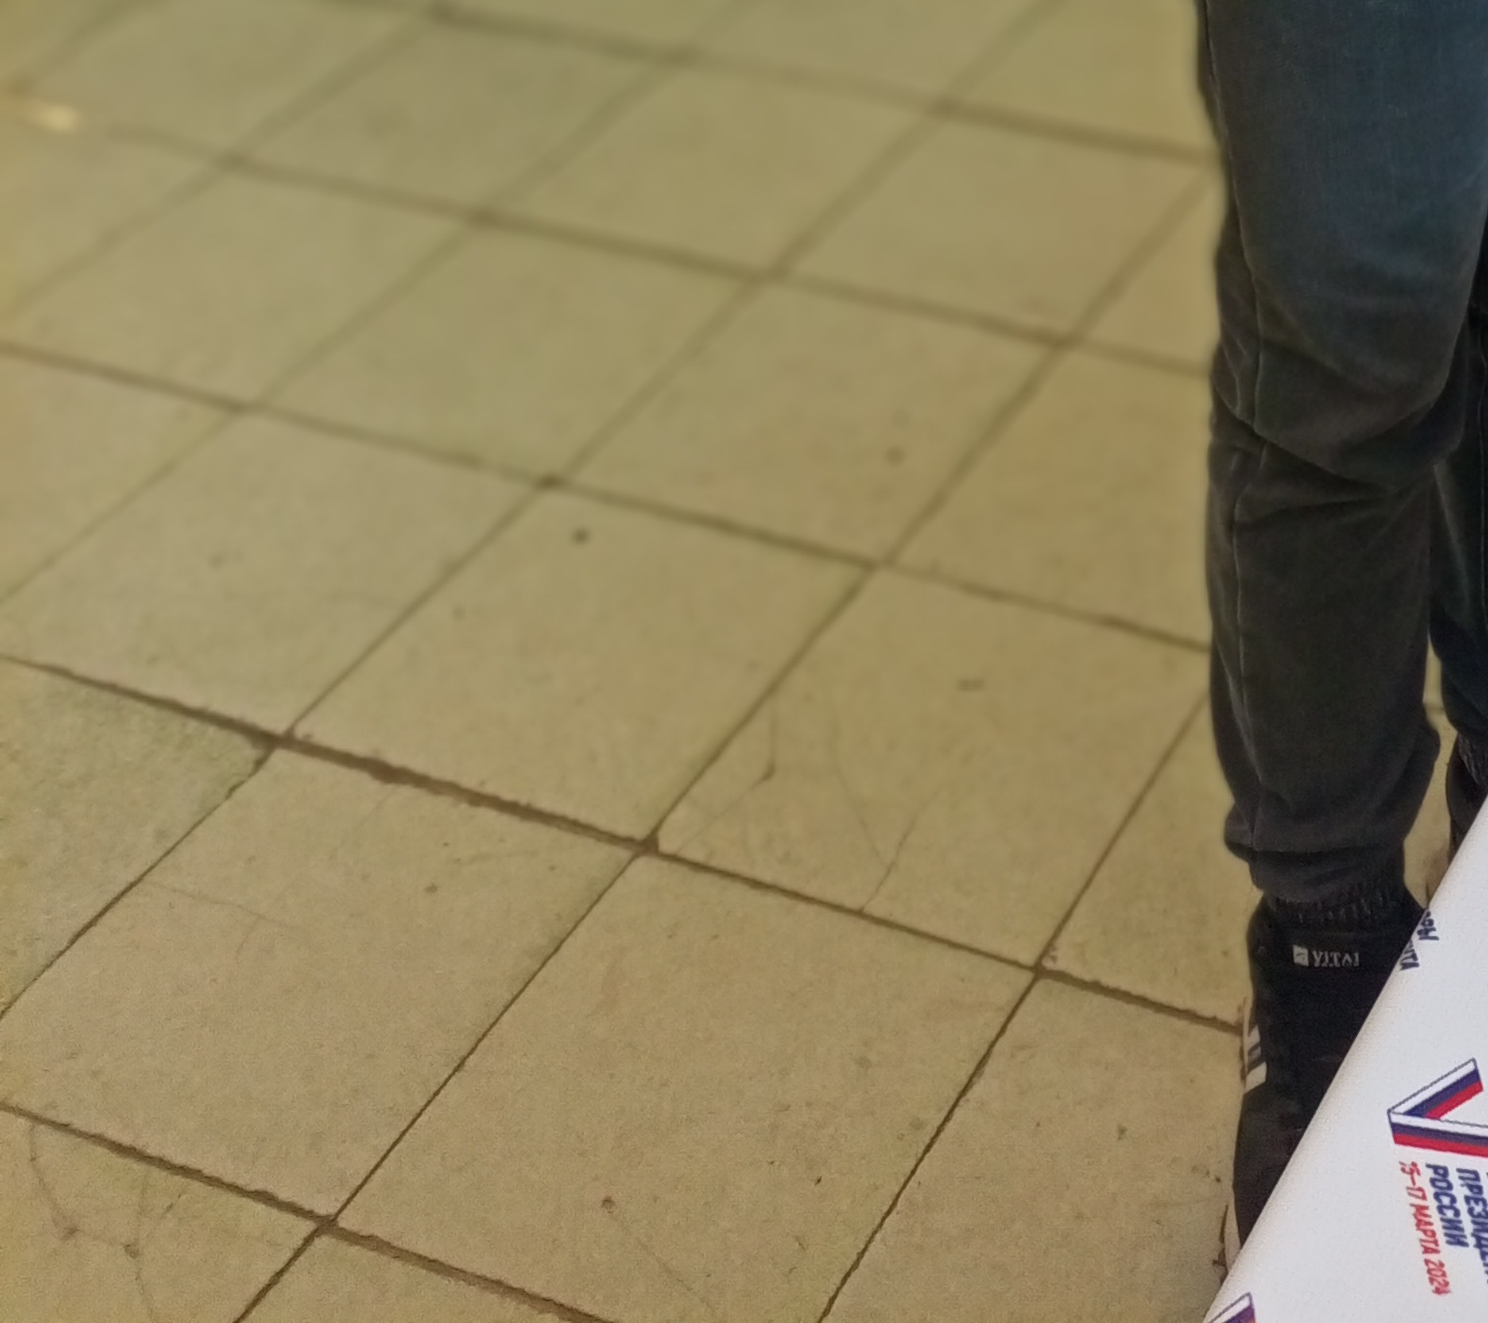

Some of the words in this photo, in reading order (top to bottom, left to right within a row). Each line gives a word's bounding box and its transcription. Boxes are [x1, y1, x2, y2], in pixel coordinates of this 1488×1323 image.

[1409, 1203, 1441, 1255] МАРТА
[1425, 1163, 1469, 1248] РОССИИ
[1423, 1258, 1450, 1295] 2024
